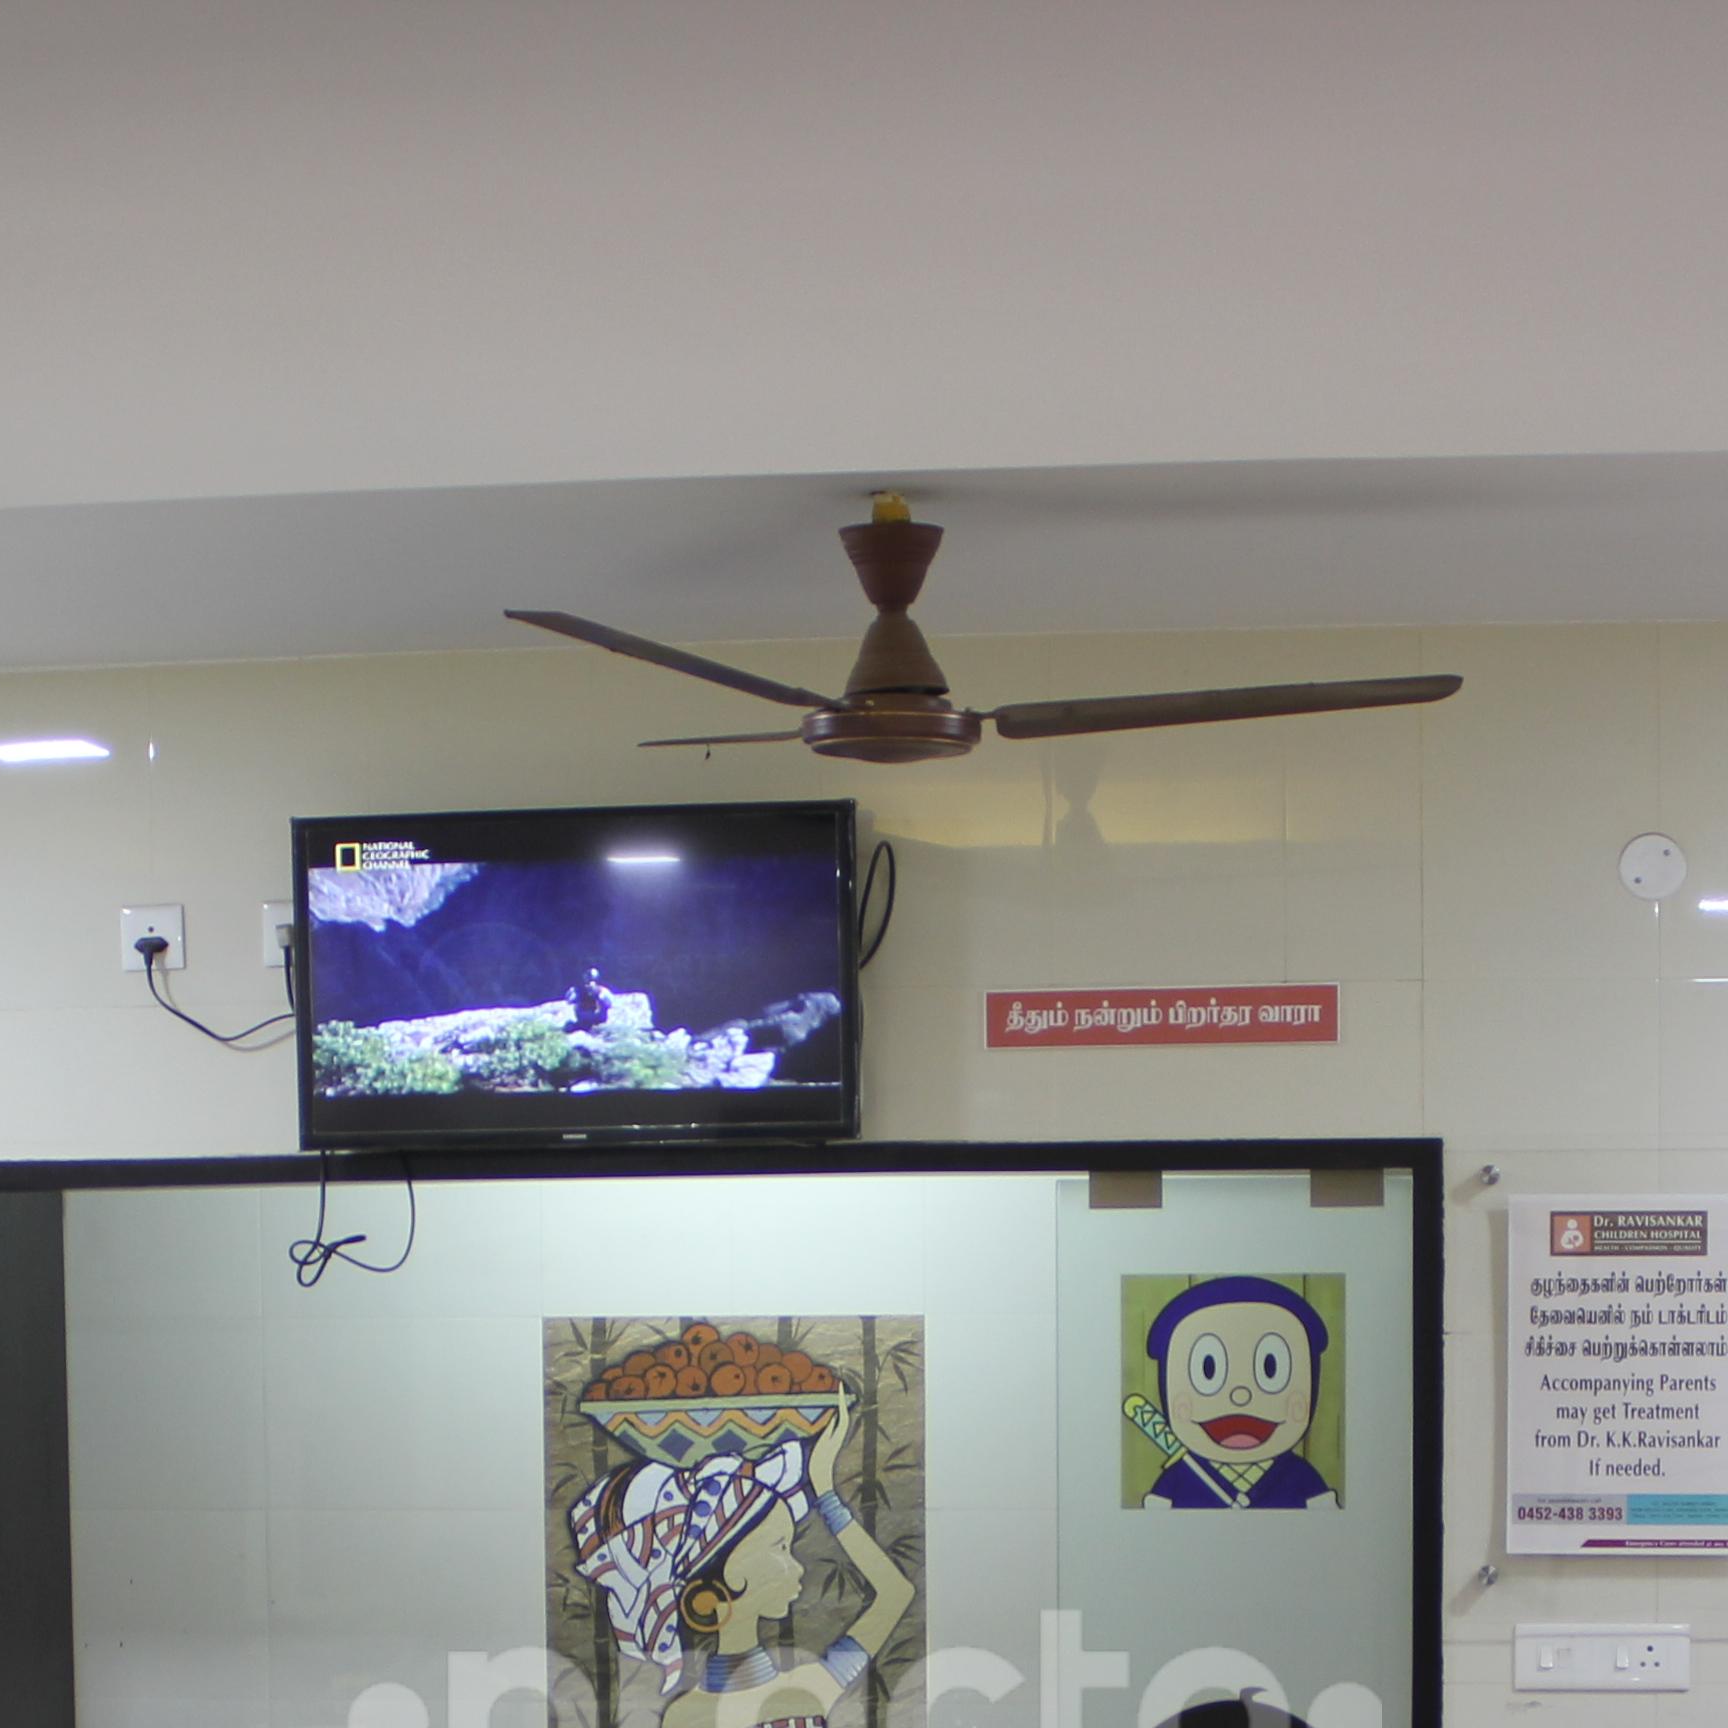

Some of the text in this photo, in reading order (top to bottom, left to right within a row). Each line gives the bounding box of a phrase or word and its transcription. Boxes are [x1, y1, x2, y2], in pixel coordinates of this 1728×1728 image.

[1005, 997, 1322, 1033] தீதும் நன்றும் பிறர்தர வாரா
[1593, 1215, 1703, 1228] Dr. RAVISANKAR
[1594, 1230, 1701, 1240] CHILDREN HOSPITAL
[1530, 1270, 1727, 1298] குழந்தைகளின் பெற்றோர்கள்
[1530, 1303, 1626, 1328] தேவையெனில்
[1630, 1303, 1654, 1328] நம்
[1525, 1335, 1577, 1357] சிகிச்சை
[1540, 1373, 1717, 1396] Accompanying Parents
[1556, 1402, 1700, 1425] may get Treatment
[1535, 1429, 1721, 1448] from Dr. K.K.Ravisankar
[1589, 1458, 1665, 1477] If needed.
[1518, 1506, 1584, 1521] 0452-438
[1588, 1506, 1623, 1521] 3393
